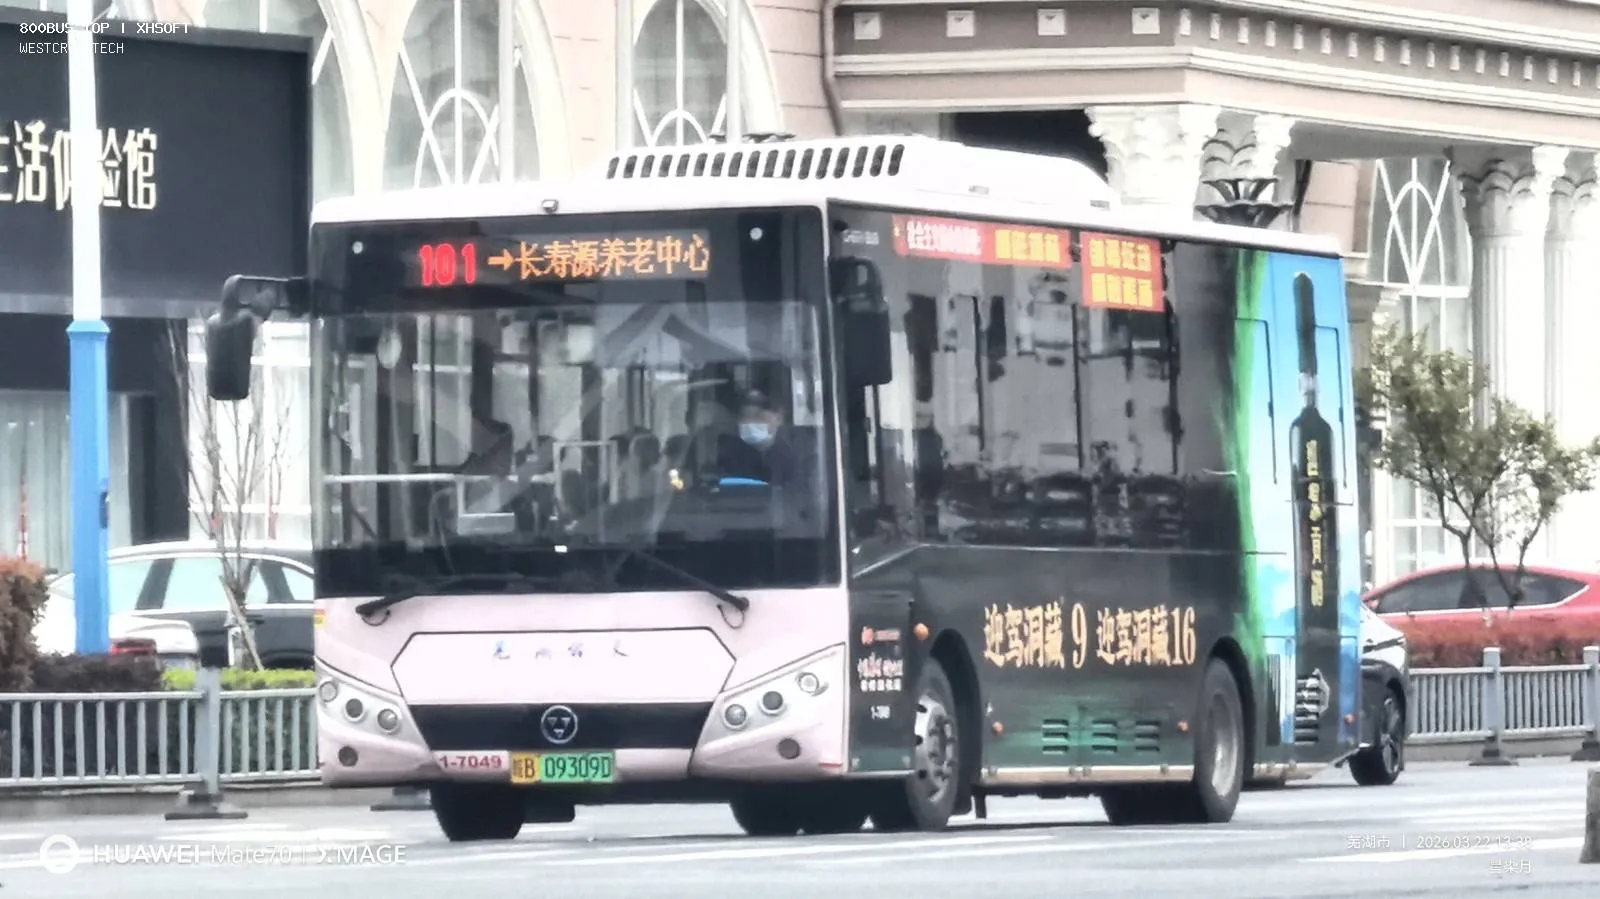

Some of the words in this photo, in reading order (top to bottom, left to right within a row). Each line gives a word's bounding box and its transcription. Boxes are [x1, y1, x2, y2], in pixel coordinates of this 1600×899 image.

[420, 243, 477, 286] 101
[515, 232, 711, 280] 长寿源养老中心
[1071, 603, 1088, 670] 9
[439, 754, 503, 770] 1-7049
